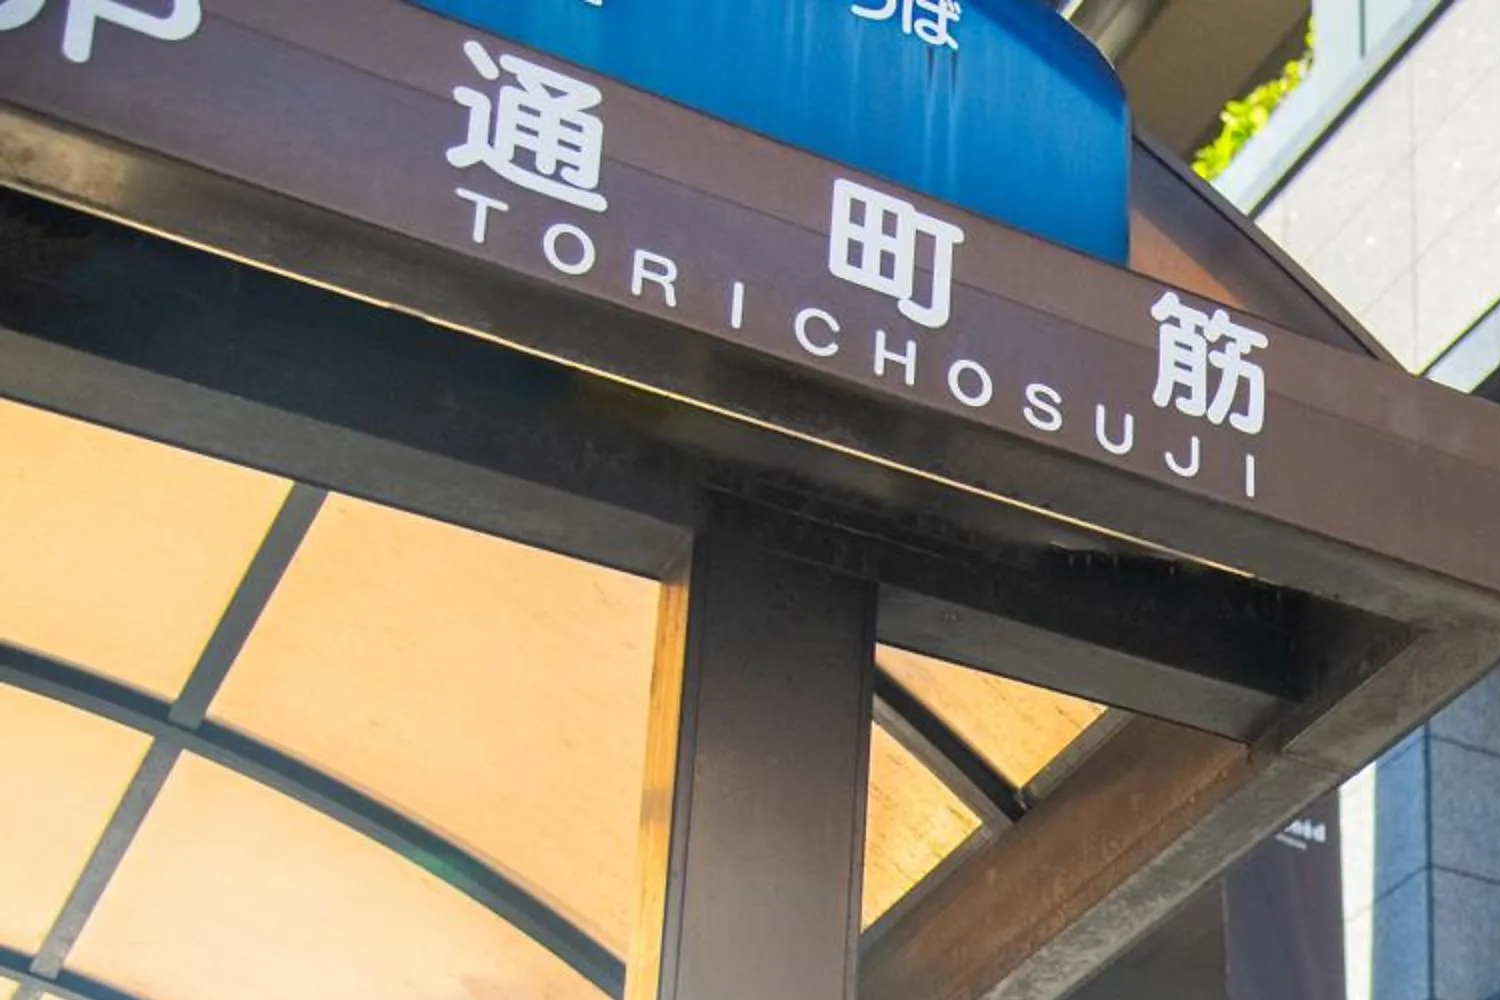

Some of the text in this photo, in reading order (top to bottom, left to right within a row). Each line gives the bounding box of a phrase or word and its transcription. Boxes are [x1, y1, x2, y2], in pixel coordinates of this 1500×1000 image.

[445, 39, 1269, 434] 通町筋
[454, 186, 1256, 498] TORICHOSUJI
